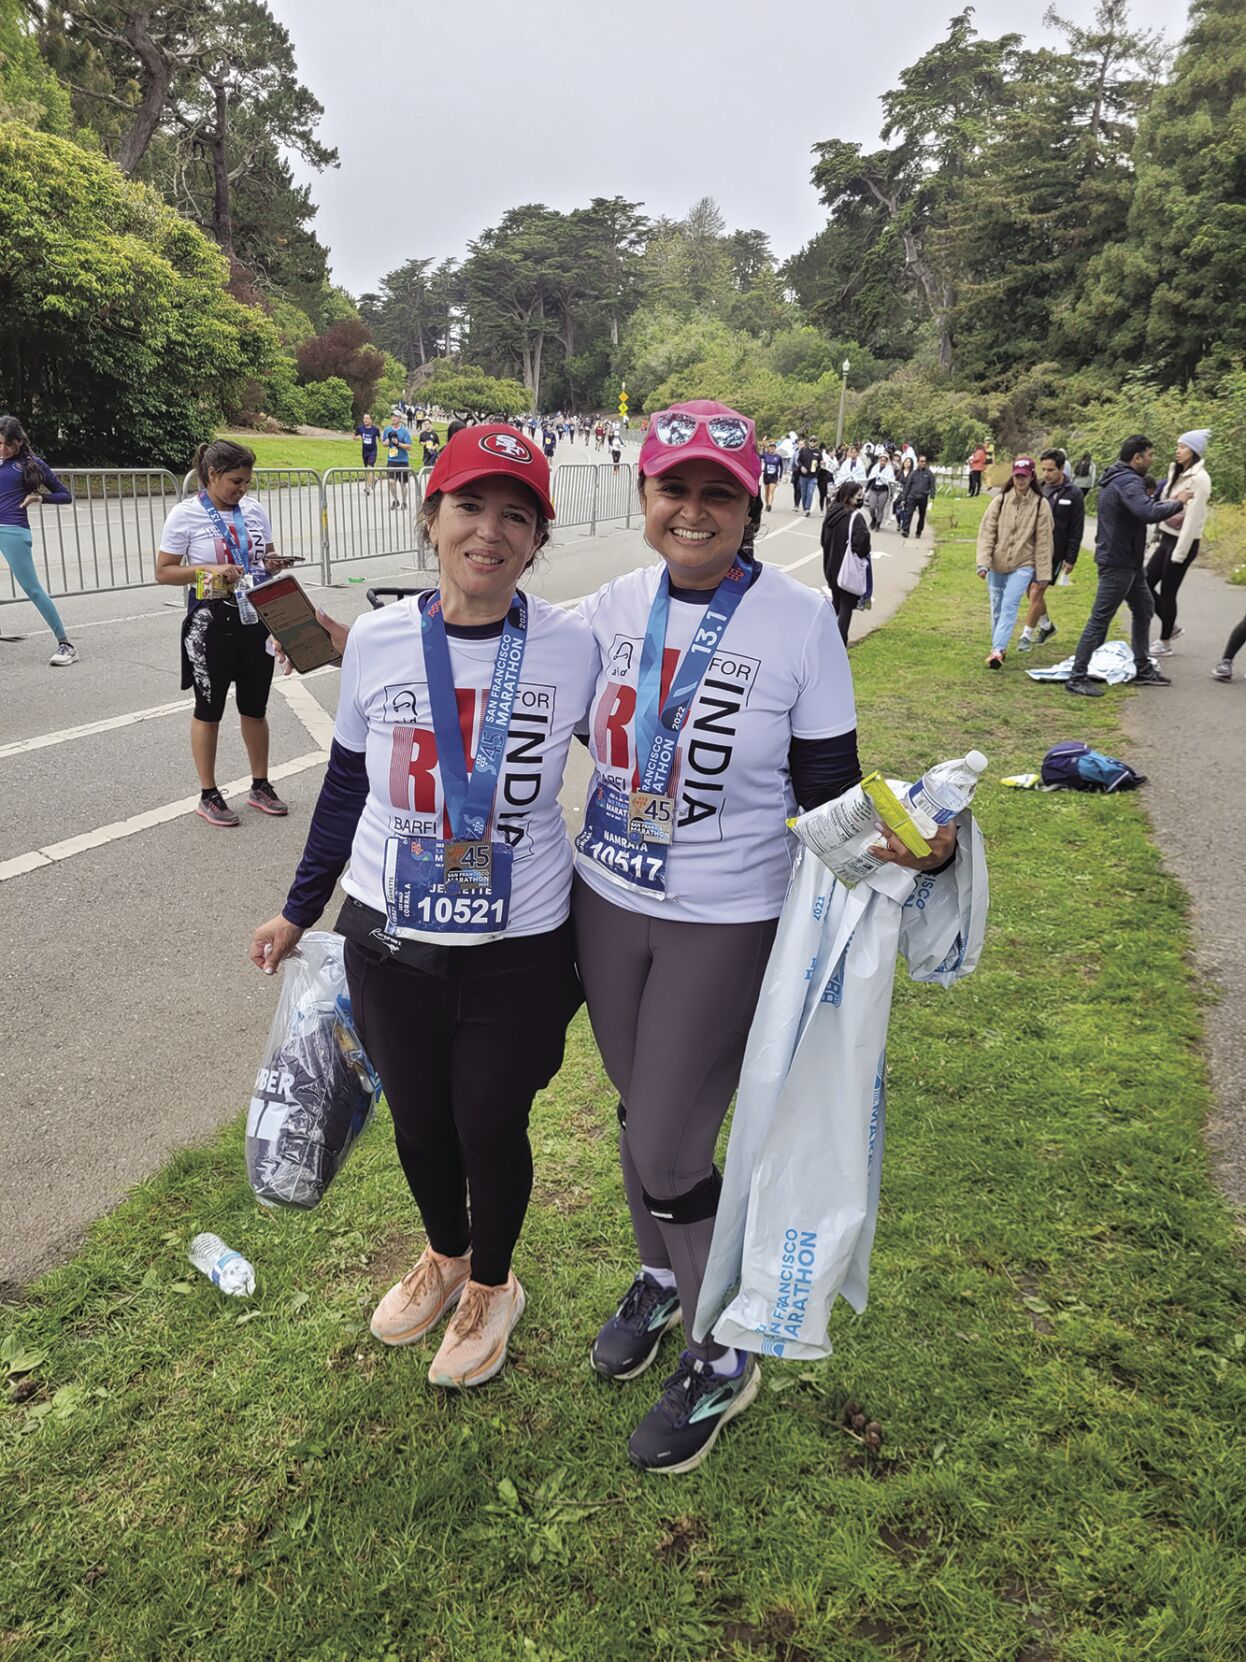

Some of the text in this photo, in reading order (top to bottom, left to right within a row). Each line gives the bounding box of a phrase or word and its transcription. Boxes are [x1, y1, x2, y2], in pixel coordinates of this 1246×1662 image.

[518, 607, 528, 630] 2022
[691, 610, 728, 655] 13.1
[486, 634, 512, 724] SAN FRANCISCO
[496, 637, 524, 726] MARATHON
[708, 656, 752, 682] FOR
[672, 706, 686, 732] 2022
[677, 678, 745, 828] INDIA
[644, 800, 670, 822] 45
[394, 816, 436, 835] BARFI
[460, 845, 490, 868] 45
[590, 841, 664, 882] 10517
[418, 896, 504, 924] 10521
[775, 1228, 798, 1322] FRANCISCO
